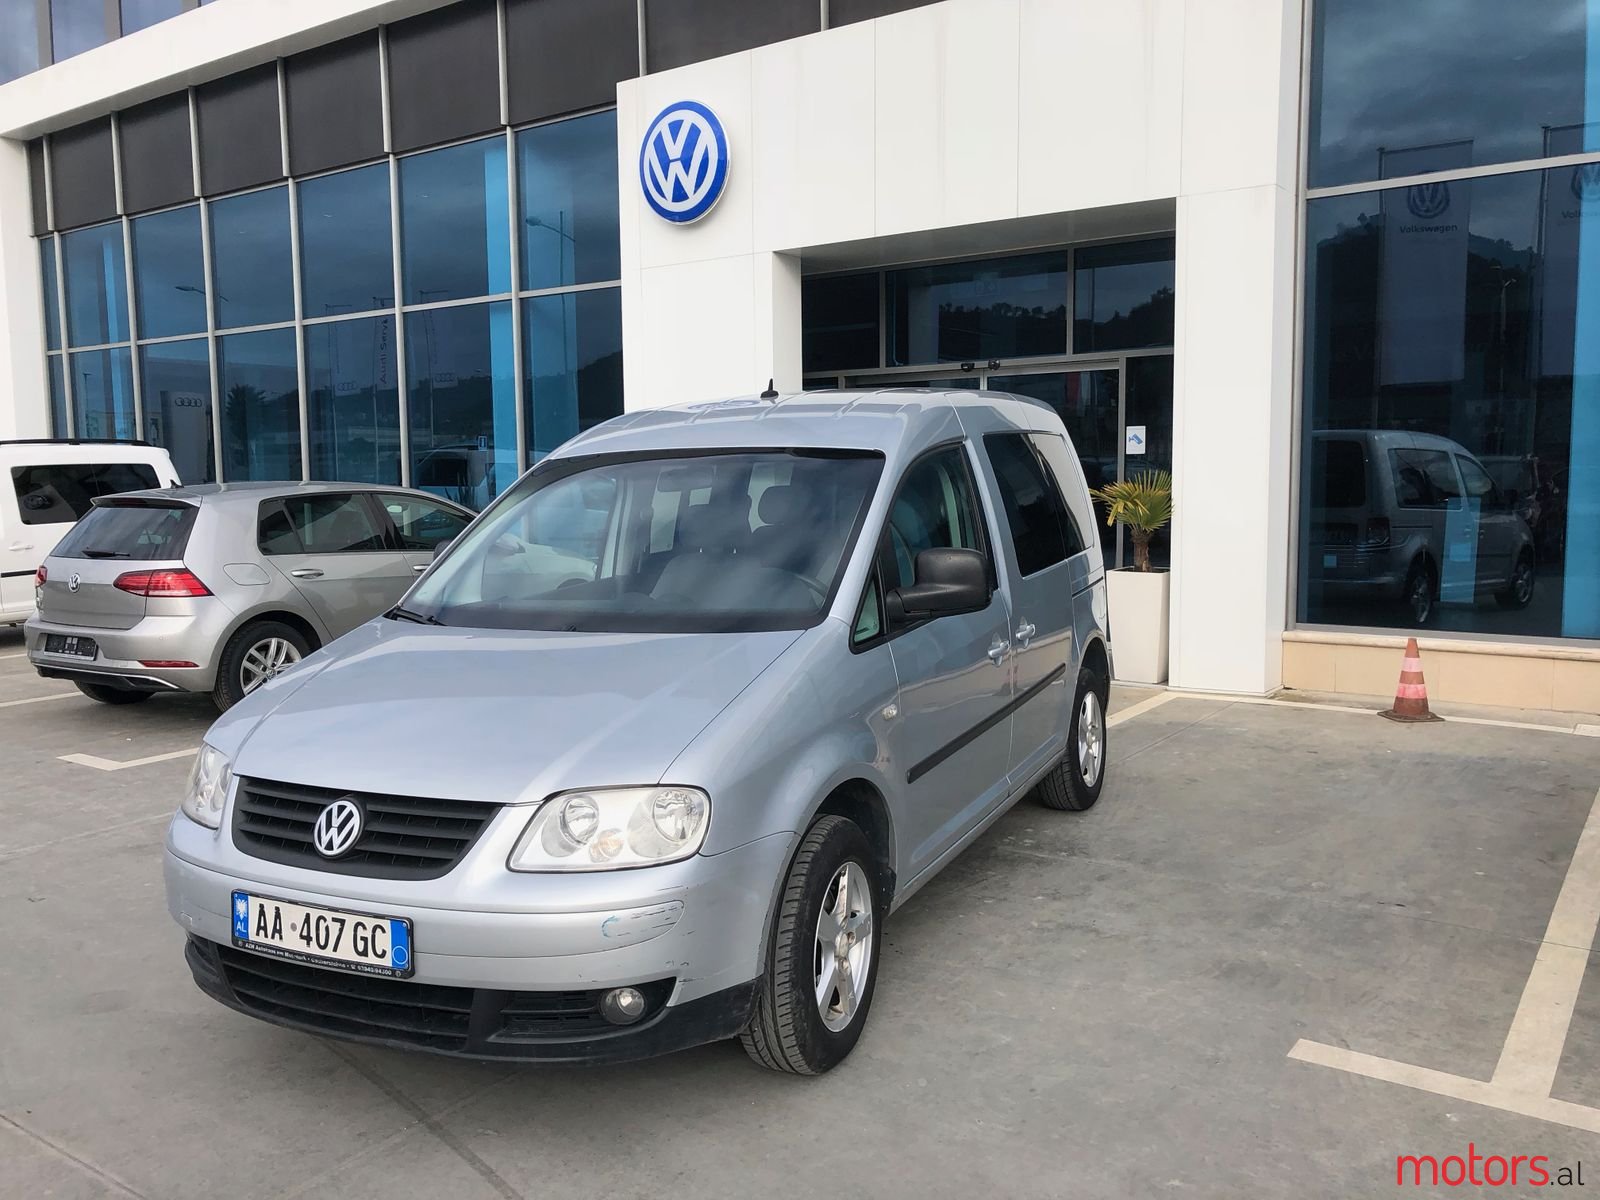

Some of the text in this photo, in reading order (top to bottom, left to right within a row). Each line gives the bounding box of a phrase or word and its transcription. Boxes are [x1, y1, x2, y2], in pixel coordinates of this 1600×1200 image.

[643, 108, 719, 213] VW
[1400, 223, 1458, 235] Volkswagen
[314, 800, 361, 857] VW
[236, 921, 247, 933] AL
[255, 902, 388, 959] AA 407 GC
